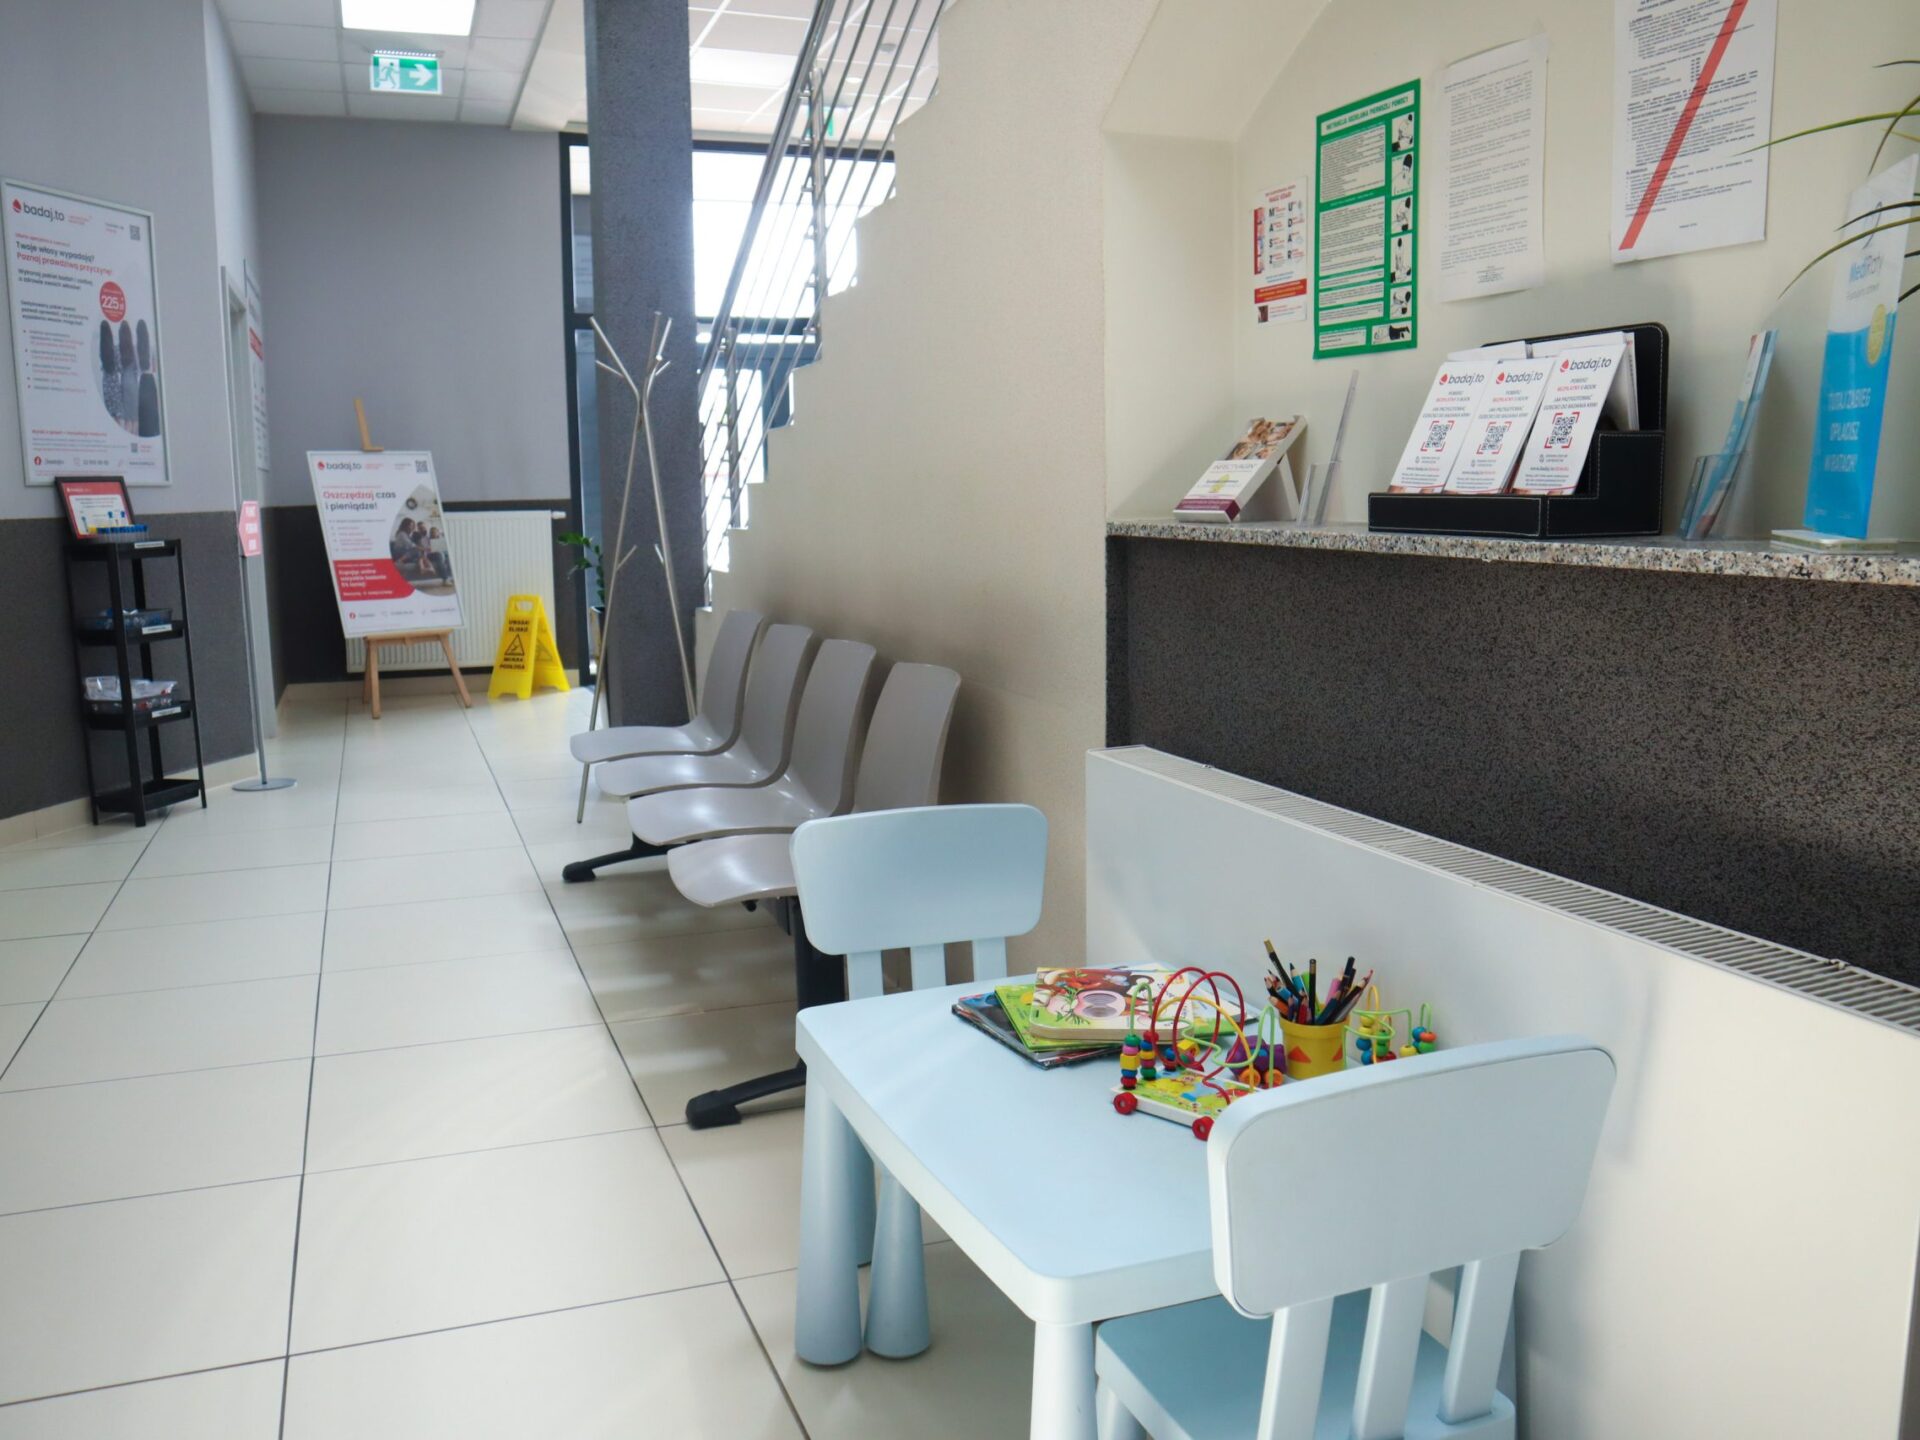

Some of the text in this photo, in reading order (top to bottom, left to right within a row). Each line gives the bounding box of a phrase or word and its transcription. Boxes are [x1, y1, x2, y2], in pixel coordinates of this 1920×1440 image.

[23, 202, 65, 222] badaj.to
[16, 252, 41, 265] Poznaj
[1569, 357, 1612, 373] badaj.to
[1448, 372, 1485, 386] badaj.to
[1505, 371, 1544, 385] badaj.to
[326, 461, 362, 472] badaj.to
[322, 490, 396, 502] Oszczędzaj czas
[330, 500, 378, 513] pieniądze!
